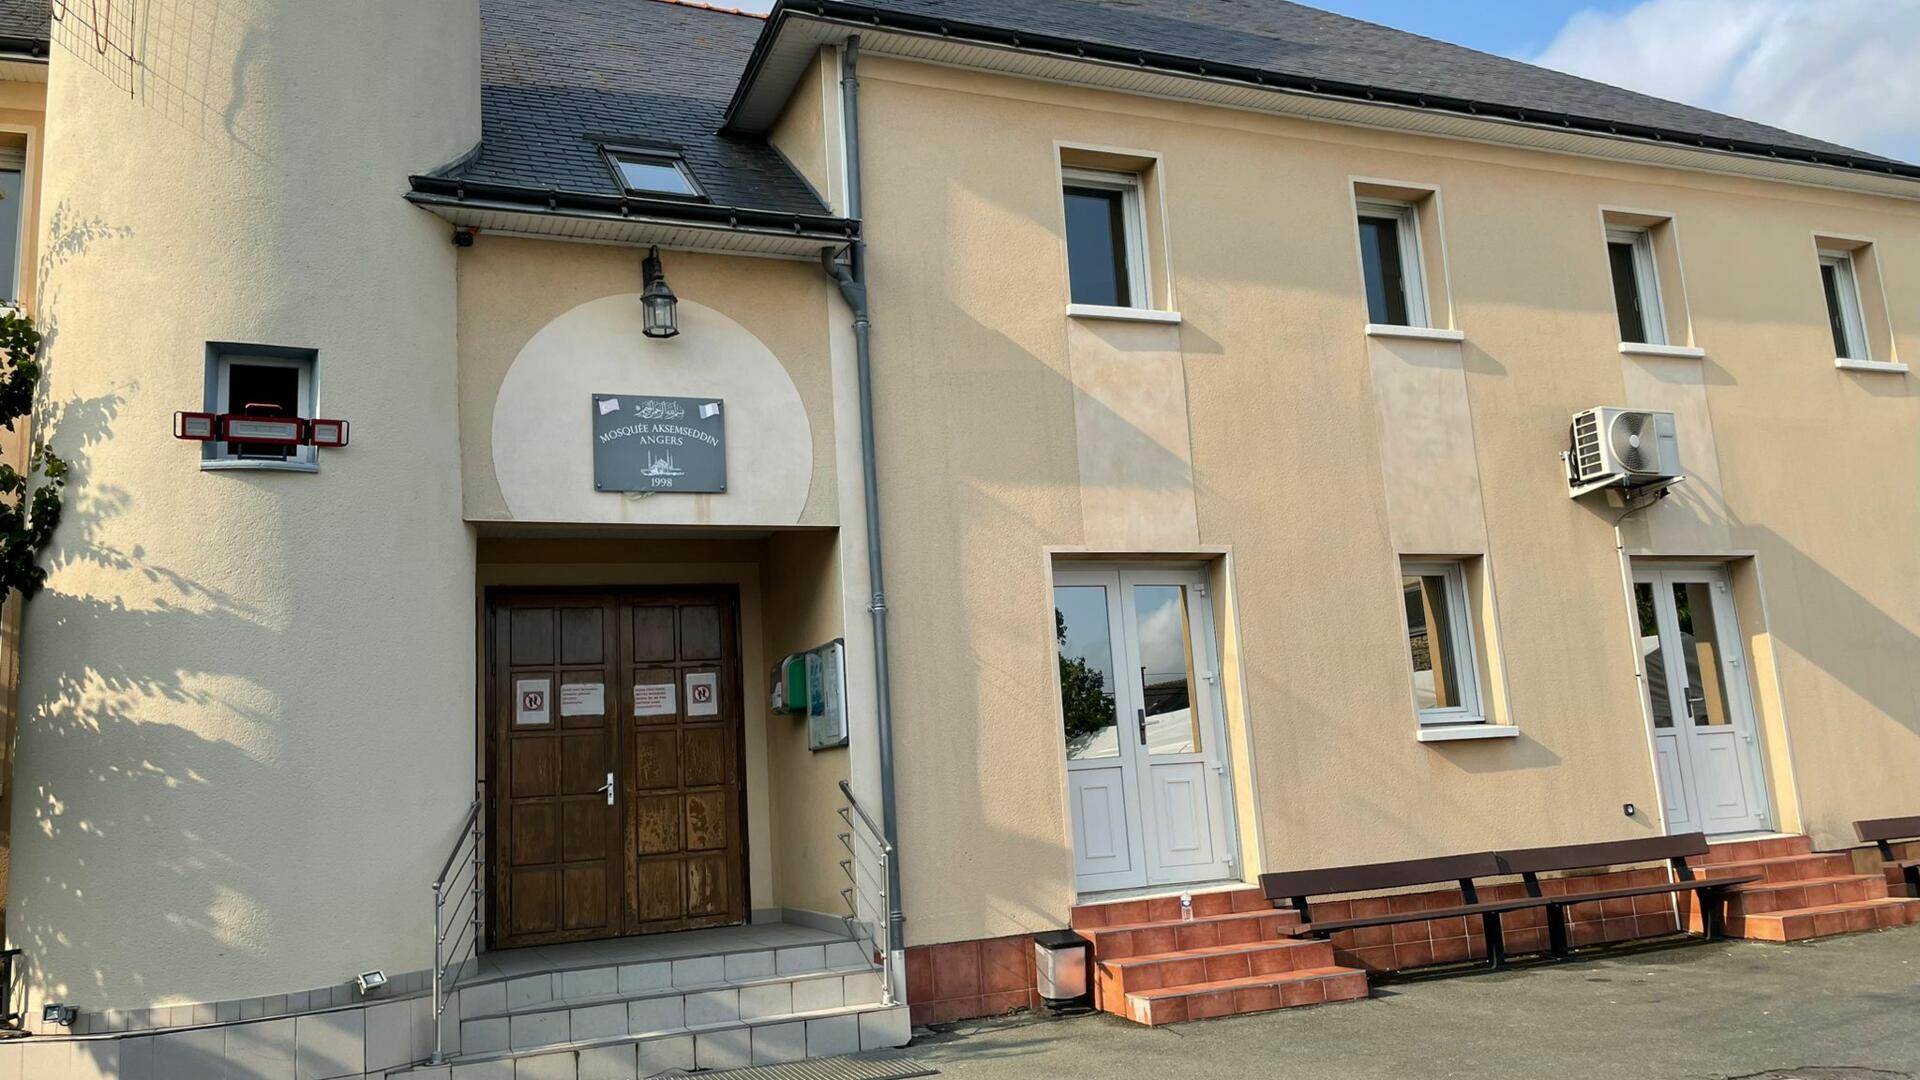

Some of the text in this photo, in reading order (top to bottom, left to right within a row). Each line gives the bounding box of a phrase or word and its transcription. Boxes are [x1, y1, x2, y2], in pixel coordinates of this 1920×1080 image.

[600, 423, 719, 446] MOSQUÉE AKSEMSEDDIN
[640, 435, 683, 446] ANGERS
[651, 478, 673, 487] 1998
